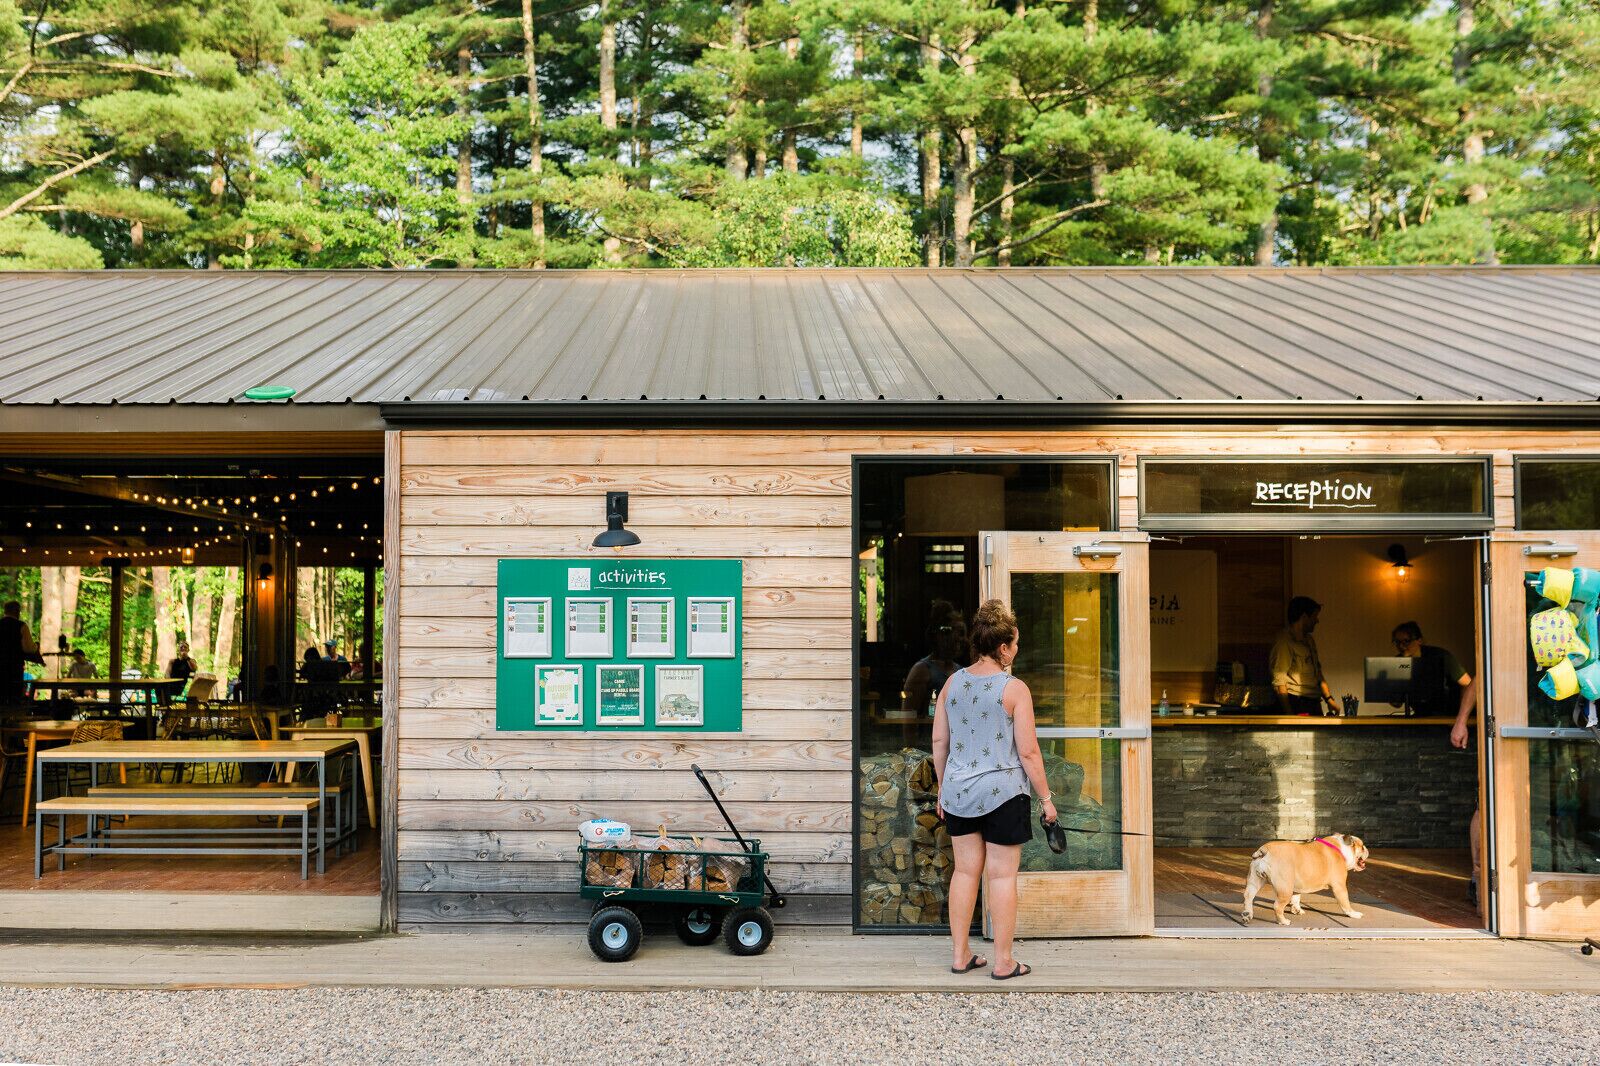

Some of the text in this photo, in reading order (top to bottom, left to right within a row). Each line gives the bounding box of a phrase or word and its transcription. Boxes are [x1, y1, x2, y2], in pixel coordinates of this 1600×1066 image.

[598, 568, 666, 585] activities
[1150, 594, 1180, 610] PIA
[1150, 616, 1176, 625] AINE
